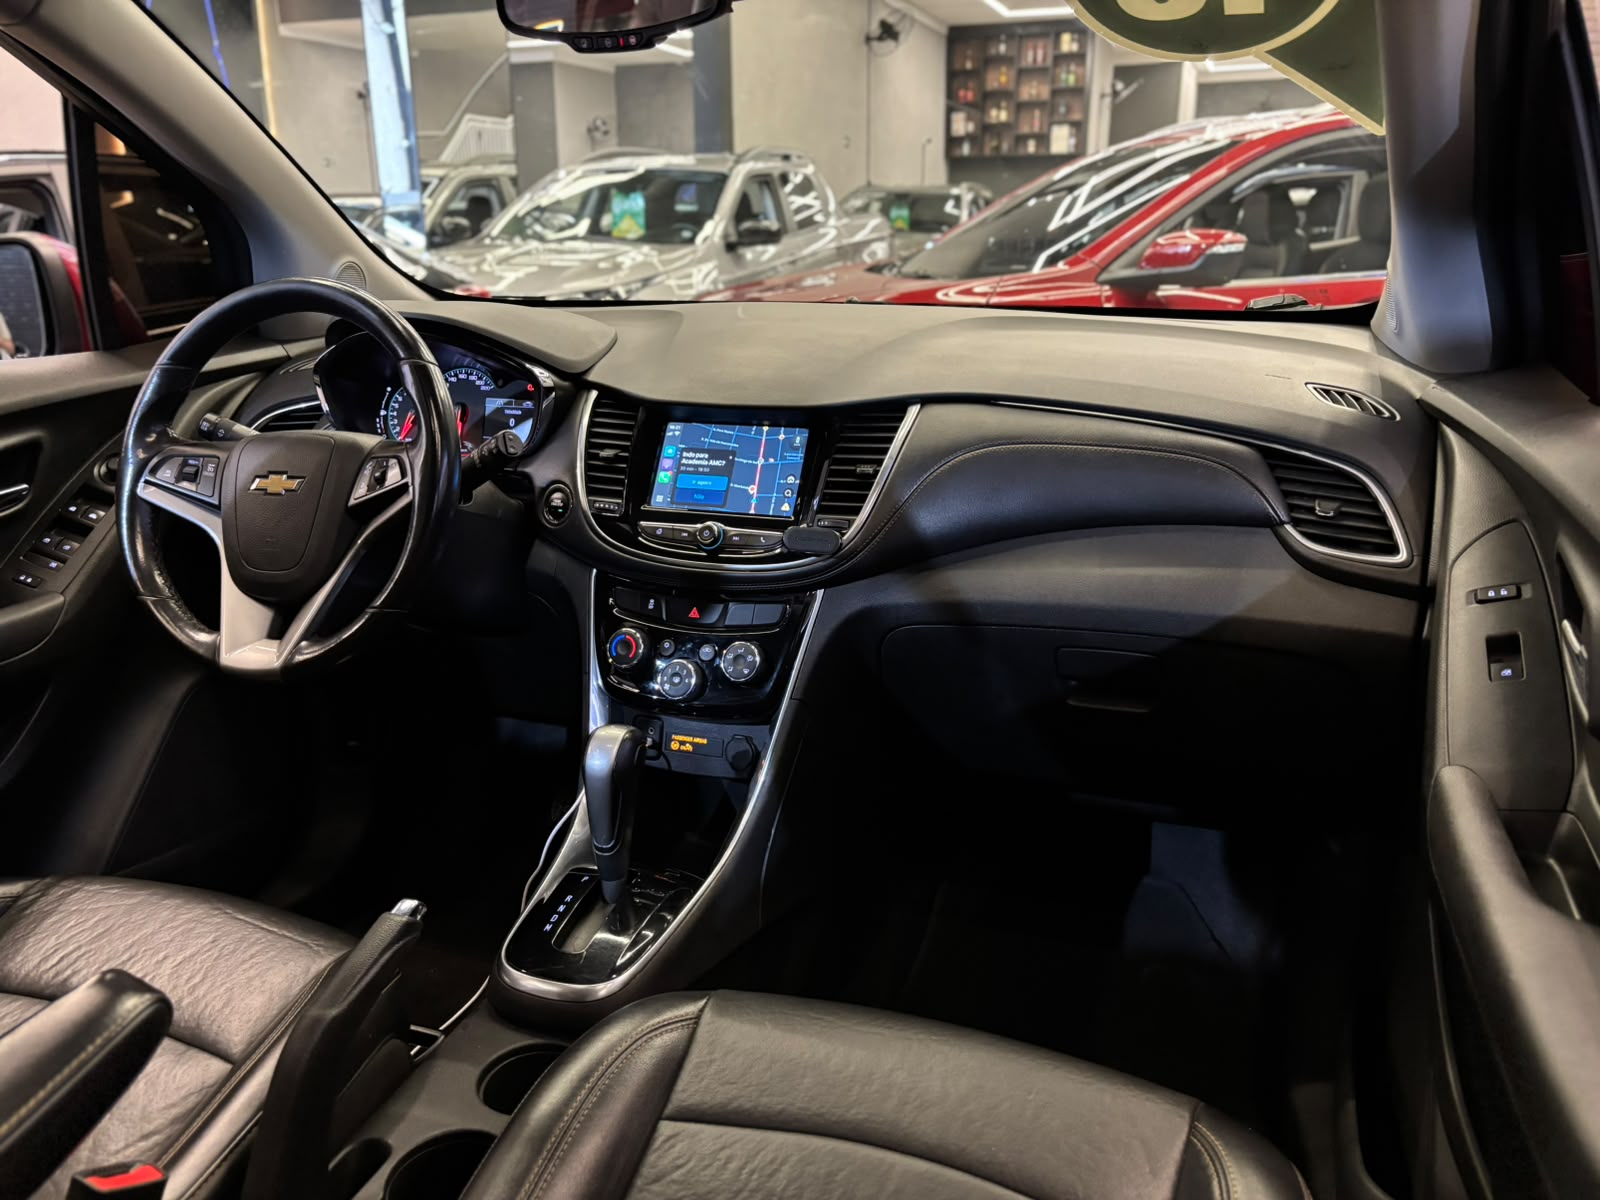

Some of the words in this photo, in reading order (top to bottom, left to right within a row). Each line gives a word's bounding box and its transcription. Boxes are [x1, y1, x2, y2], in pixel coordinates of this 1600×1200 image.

[509, 417, 515, 427] 0
[681, 458, 708, 466] Academia
[564, 894, 574, 903] R
[557, 904, 567, 912] N
[550, 914, 559, 922] D
